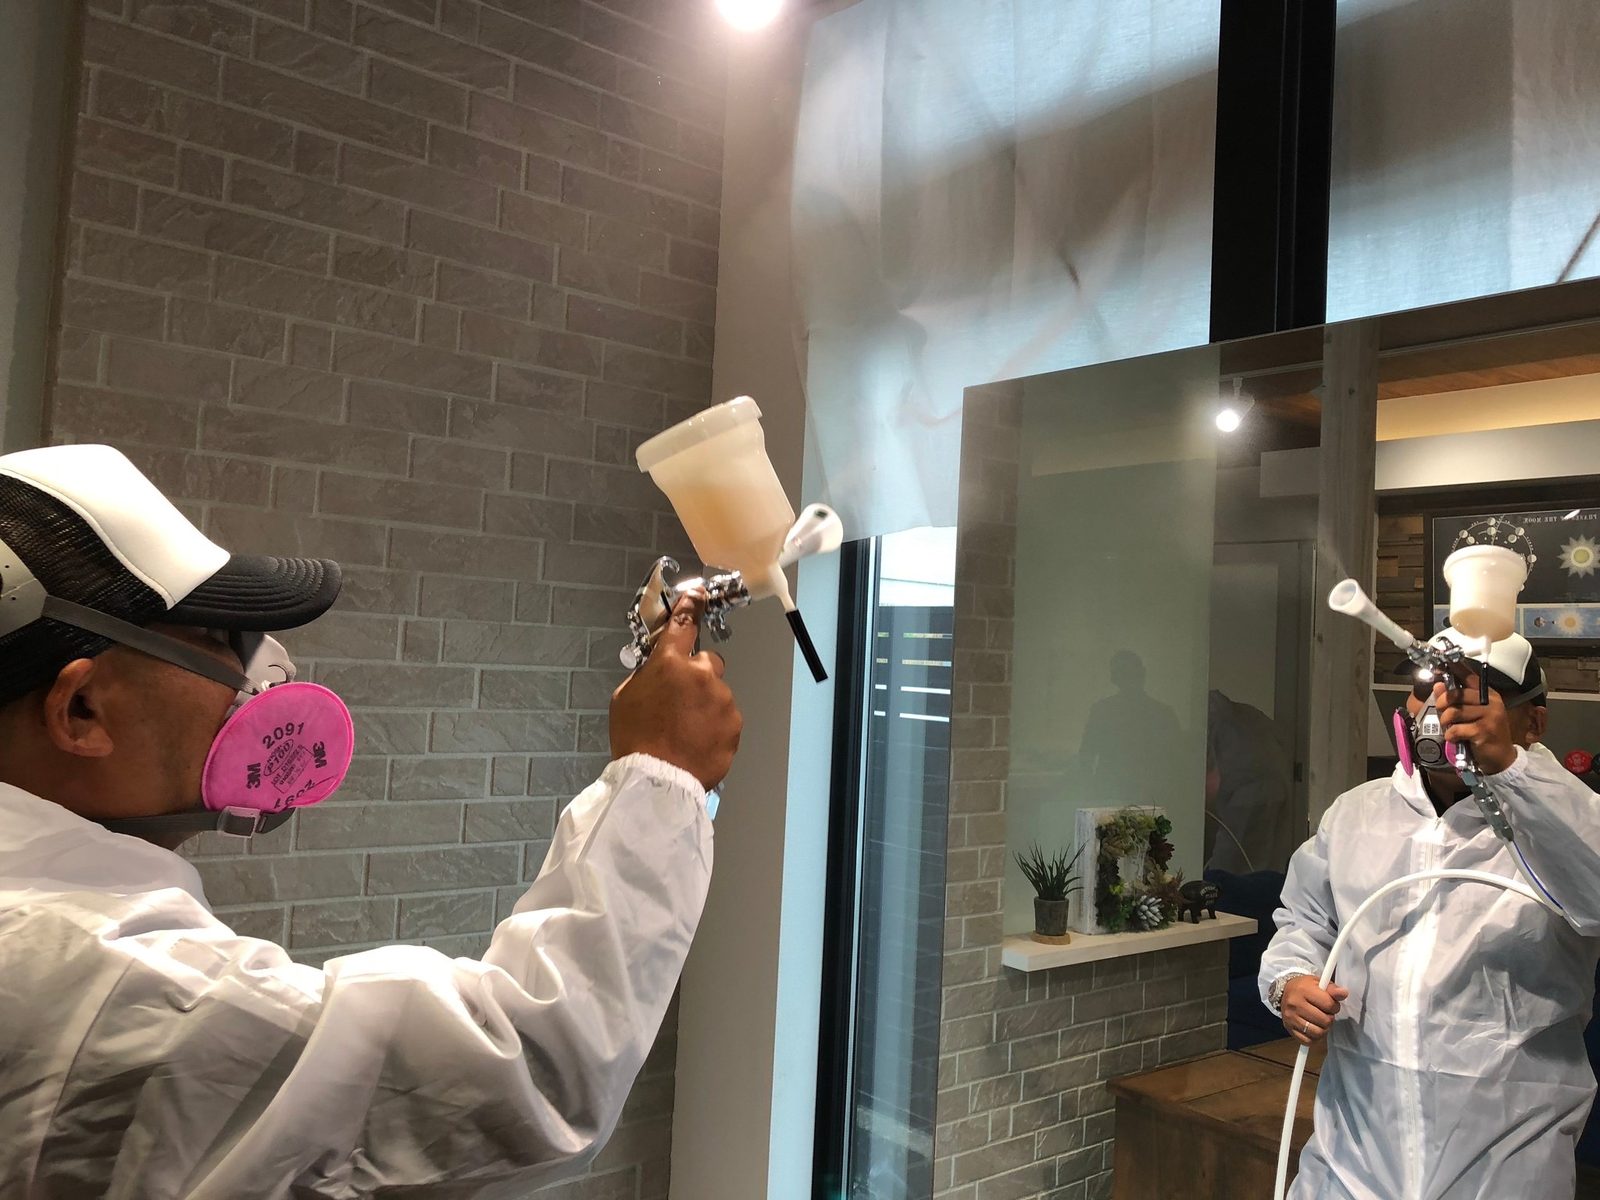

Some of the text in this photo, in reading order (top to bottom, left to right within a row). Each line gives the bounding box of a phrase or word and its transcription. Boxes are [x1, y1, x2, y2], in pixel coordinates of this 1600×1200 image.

[262, 722, 304, 749] 2091
[313, 741, 327, 768] 3M
[246, 763, 261, 789] 3M
